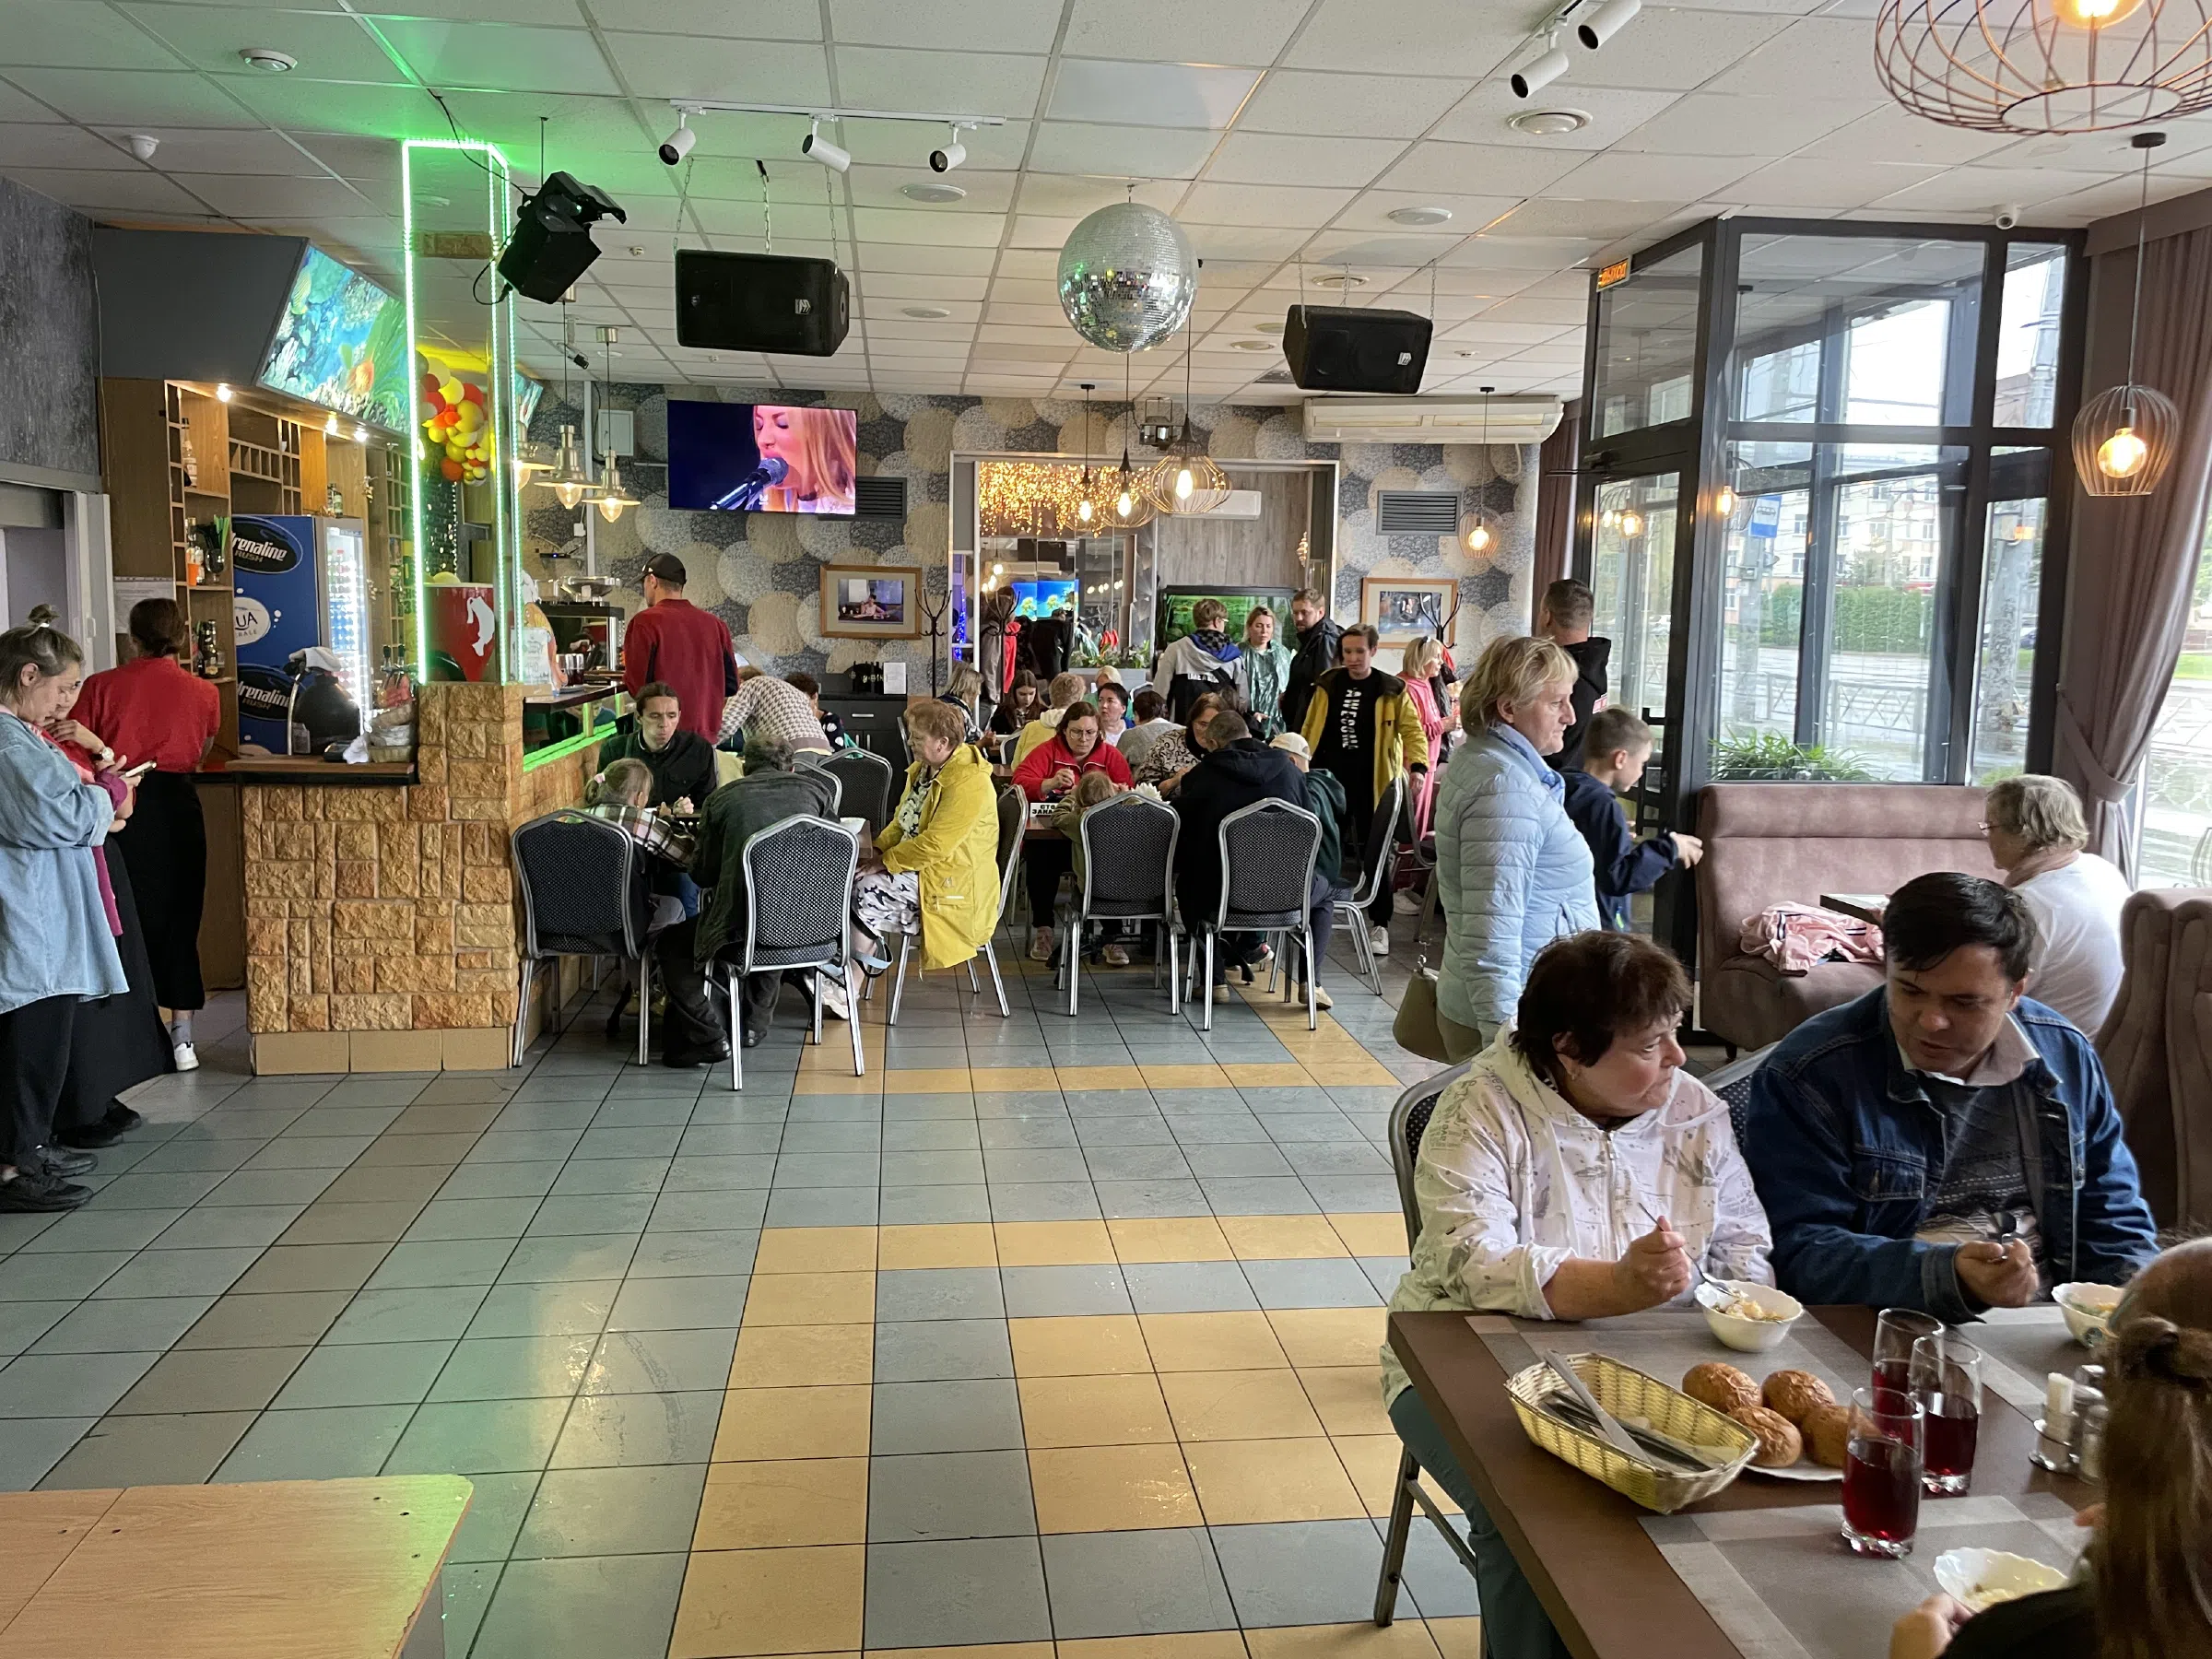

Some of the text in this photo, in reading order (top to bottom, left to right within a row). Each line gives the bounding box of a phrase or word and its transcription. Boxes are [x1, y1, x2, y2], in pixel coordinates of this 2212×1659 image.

[231, 532, 288, 561] renaline
[234, 550, 264, 562] RUSH
[235, 611, 258, 630] UA
